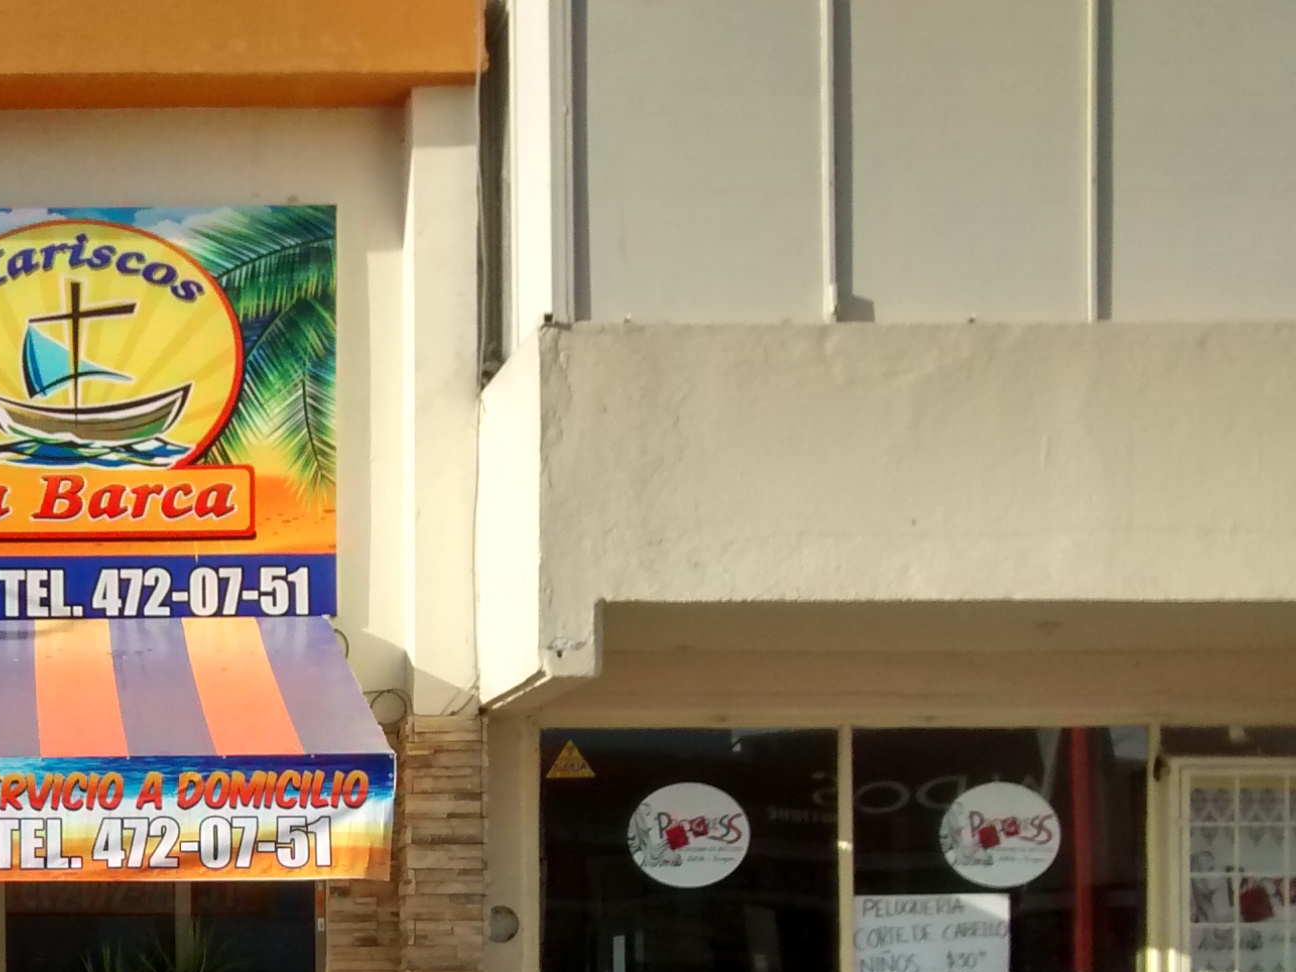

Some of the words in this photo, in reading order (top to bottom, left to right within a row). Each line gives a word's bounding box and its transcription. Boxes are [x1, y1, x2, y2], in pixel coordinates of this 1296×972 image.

[30, 474, 236, 522] Barca
[92, 566, 311, 618] 472-07-51
[135, 772, 164, 810] A
[178, 769, 369, 810] DOMICILIO
[92, 815, 333, 869] 472-07-51
